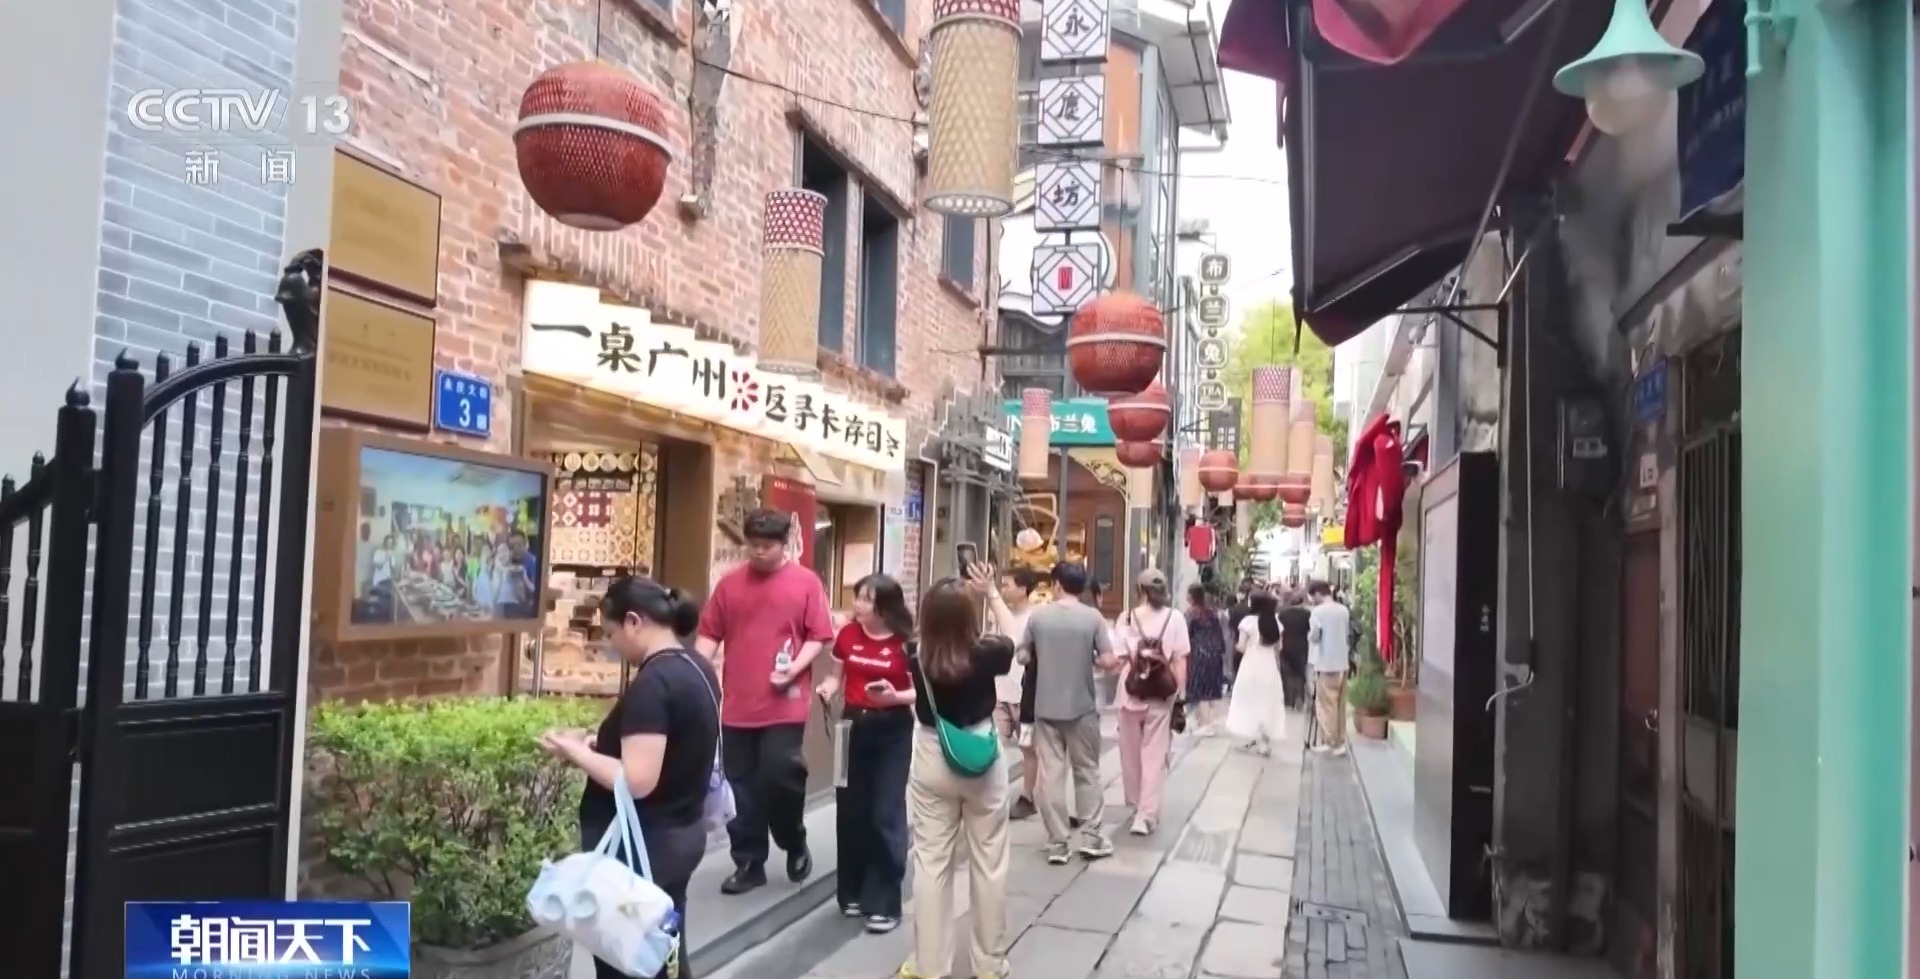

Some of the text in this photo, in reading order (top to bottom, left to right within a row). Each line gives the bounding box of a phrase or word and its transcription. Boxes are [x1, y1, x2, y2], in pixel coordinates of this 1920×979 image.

[530, 321, 727, 400] 一桌广州
[459, 398, 470, 427] 3
